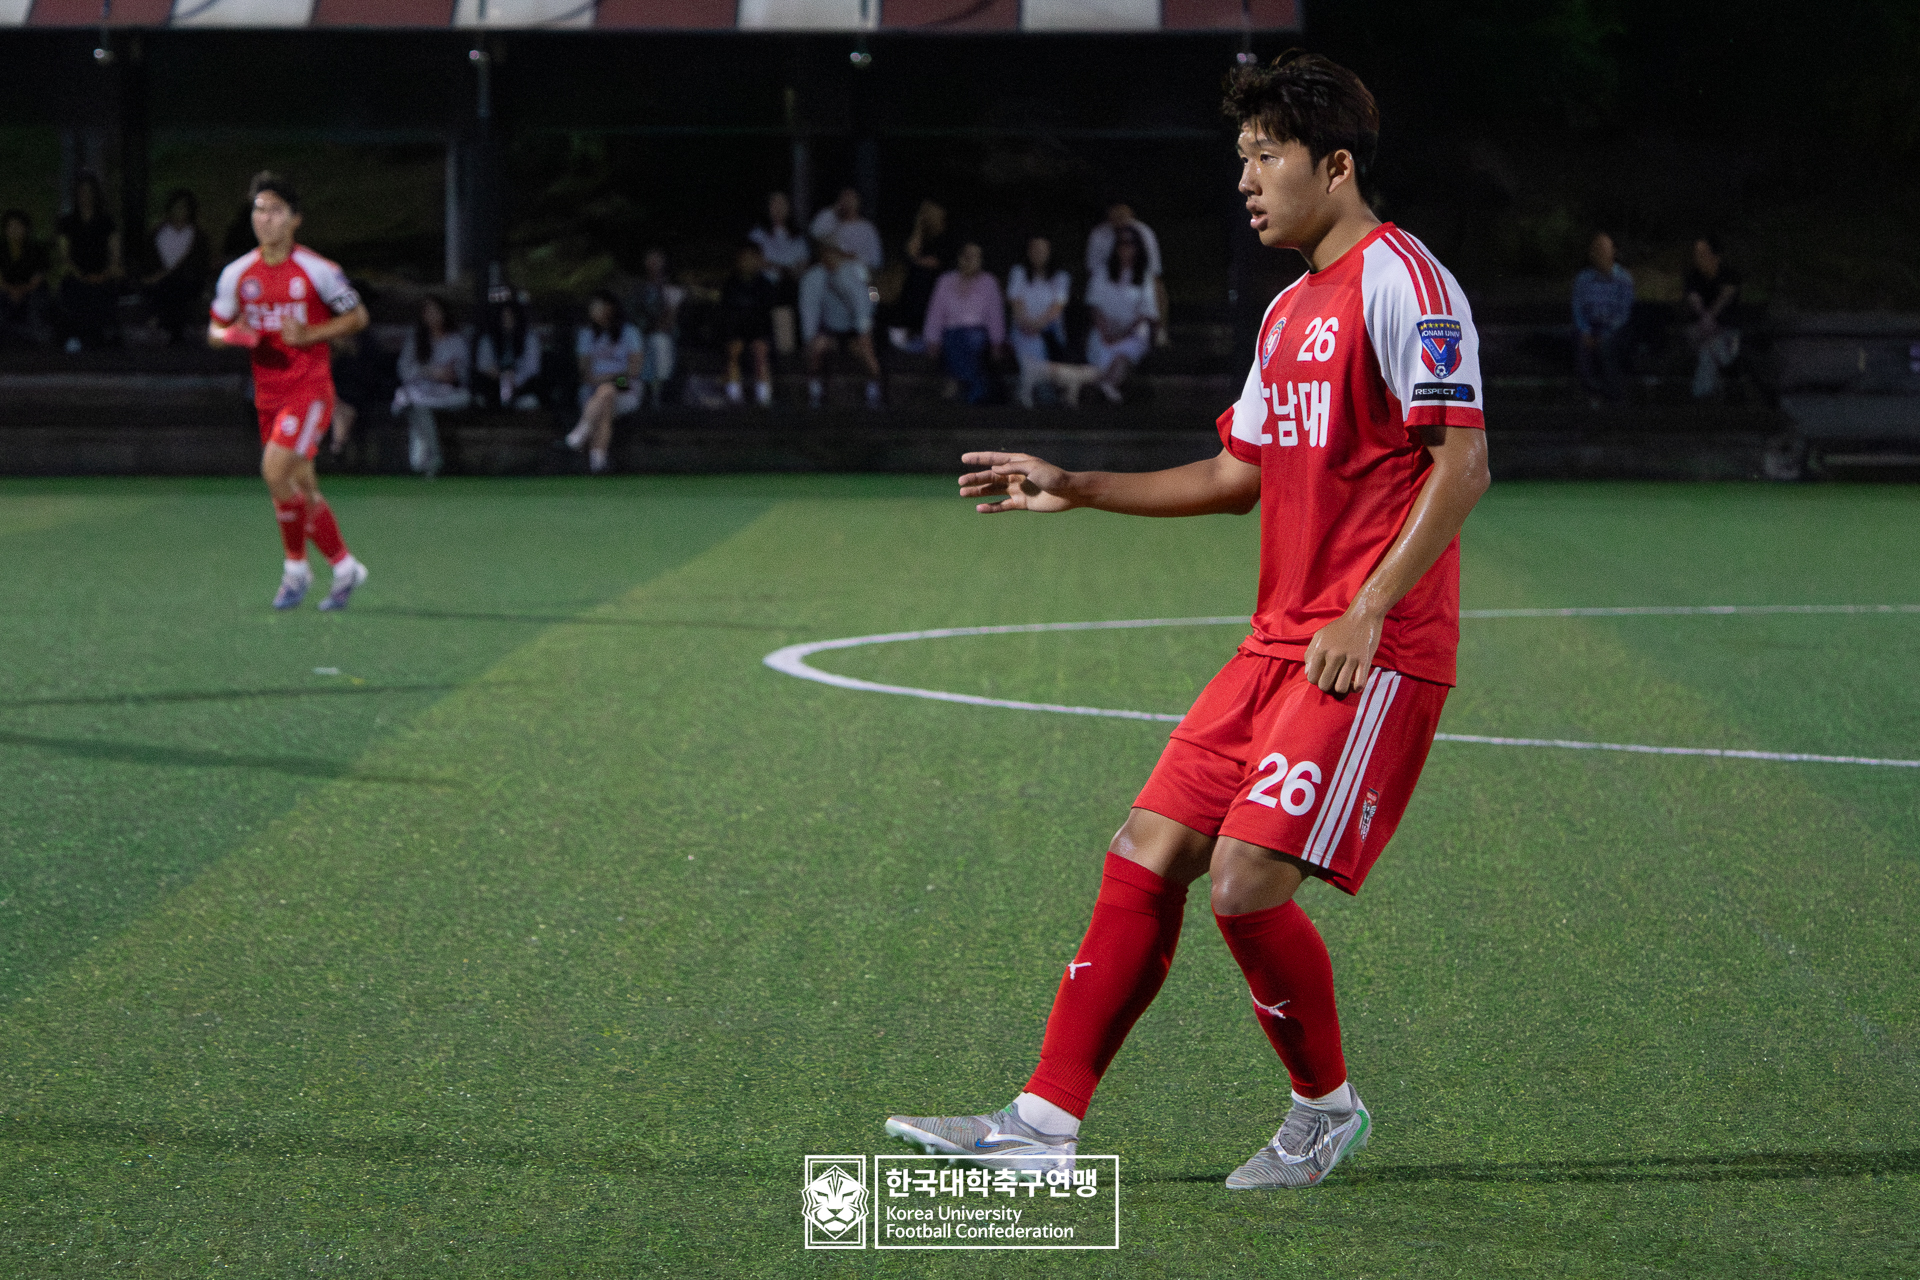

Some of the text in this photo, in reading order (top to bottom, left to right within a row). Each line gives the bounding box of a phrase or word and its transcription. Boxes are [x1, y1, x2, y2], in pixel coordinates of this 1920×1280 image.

[1296, 316, 1340, 363] 26
[1415, 387, 1456, 396] RESPECT
[1246, 752, 1322, 817] 26
